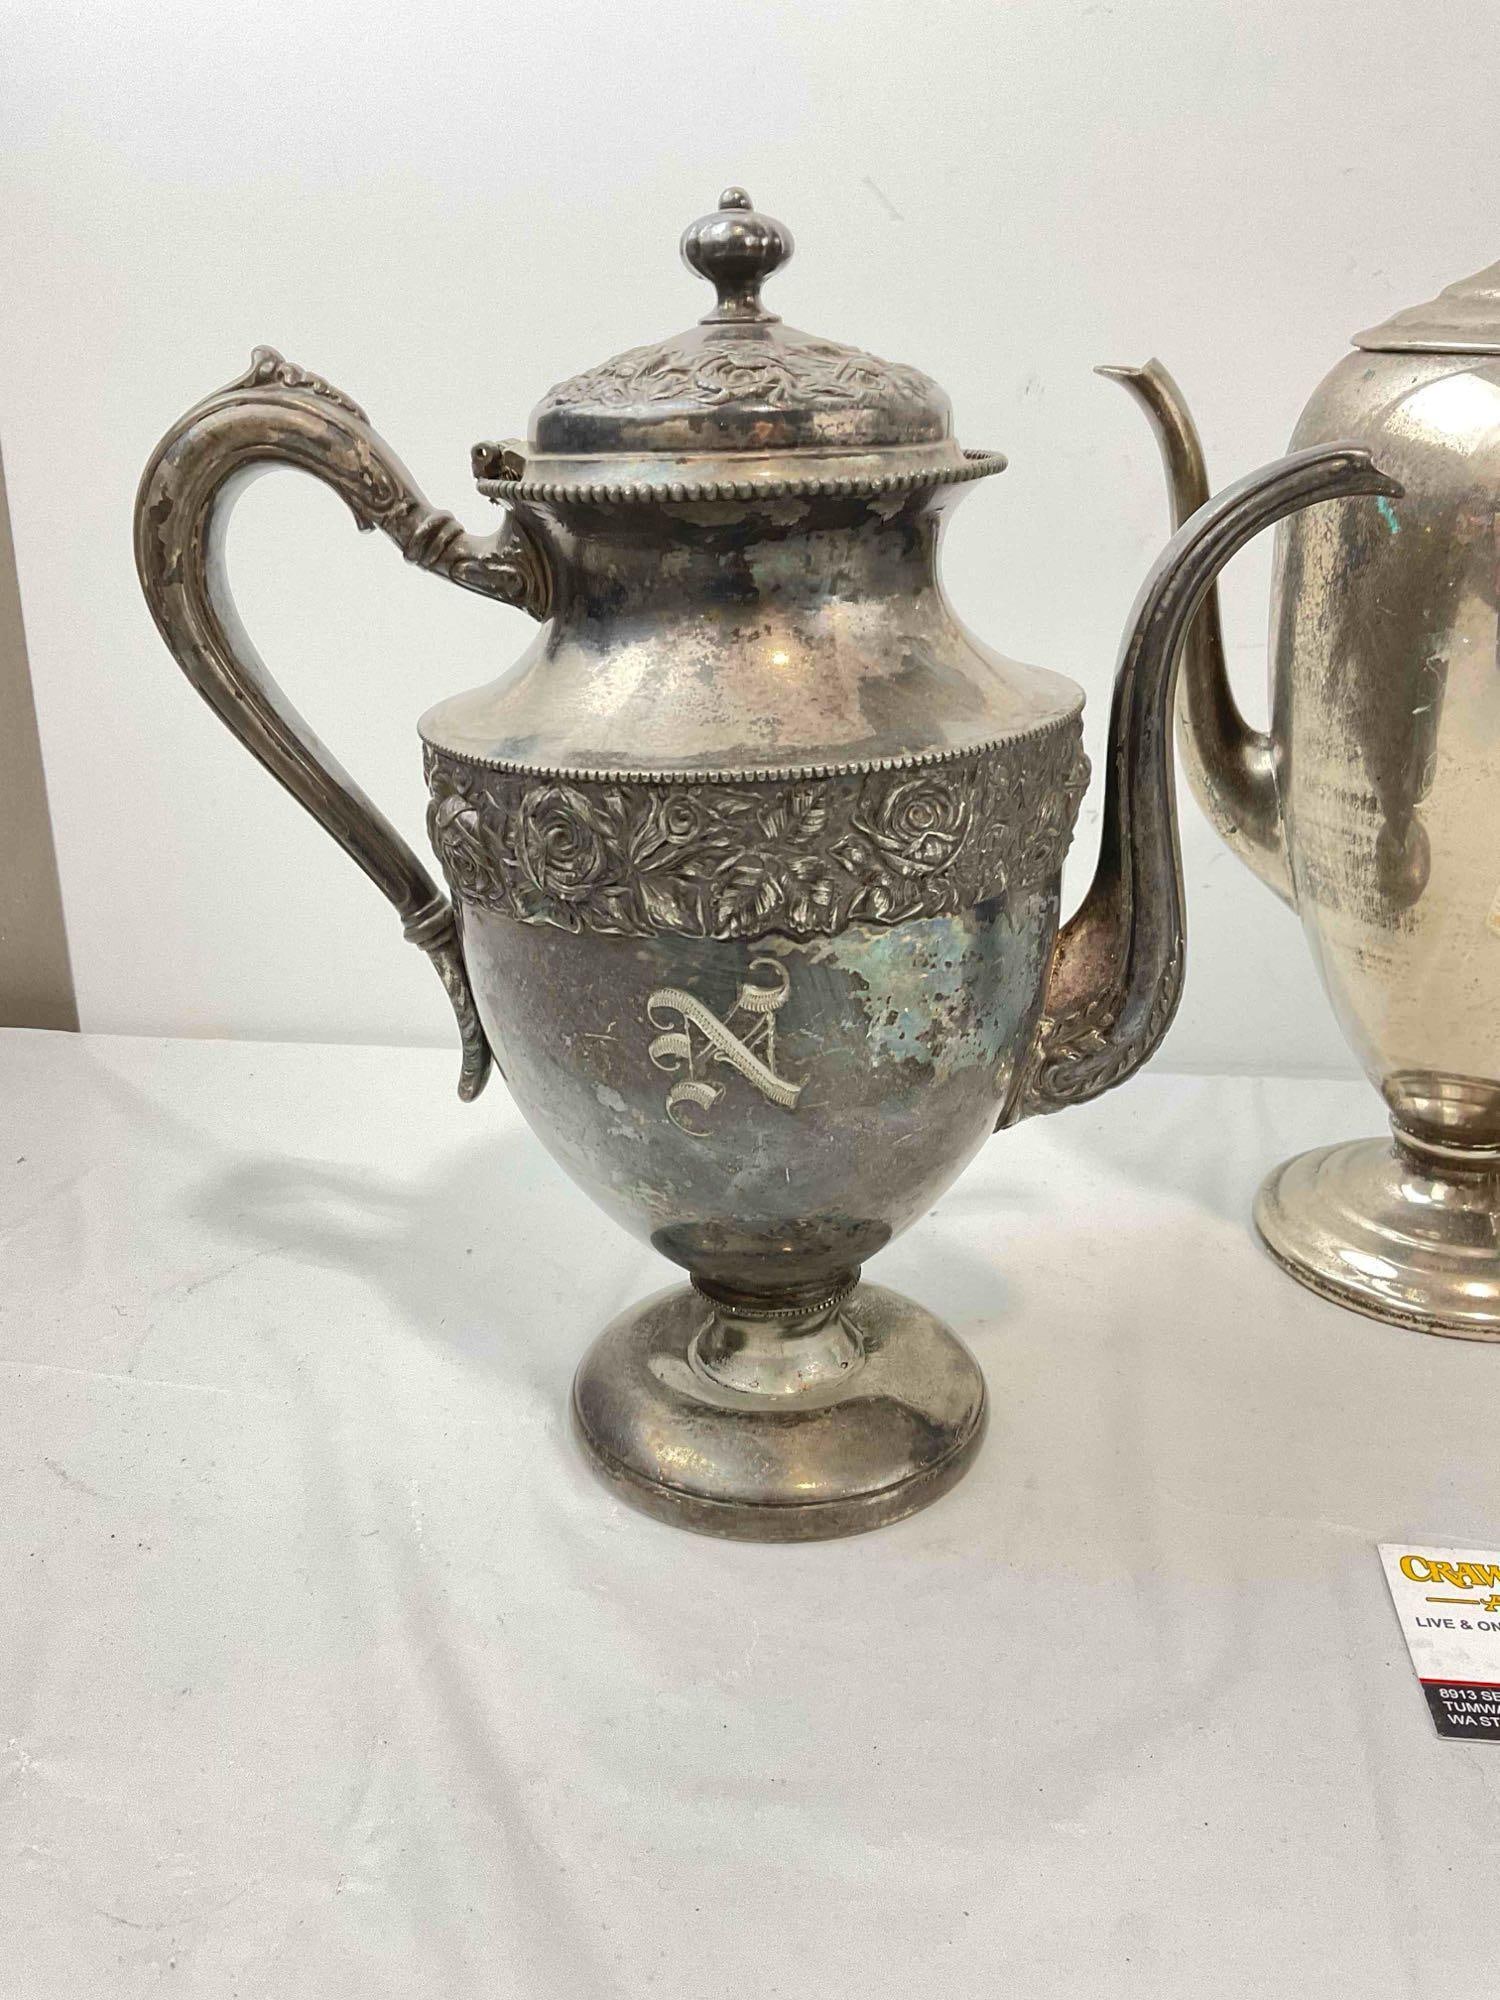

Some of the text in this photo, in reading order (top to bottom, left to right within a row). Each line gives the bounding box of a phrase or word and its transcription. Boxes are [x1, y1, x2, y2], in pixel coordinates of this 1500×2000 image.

[1416, 1617, 1455, 1630] LIVE
[1460, 1619, 1473, 1630] &
[1439, 1688, 1500, 1702] 8913 SE
[1447, 1713, 1500, 1728] WA ST
